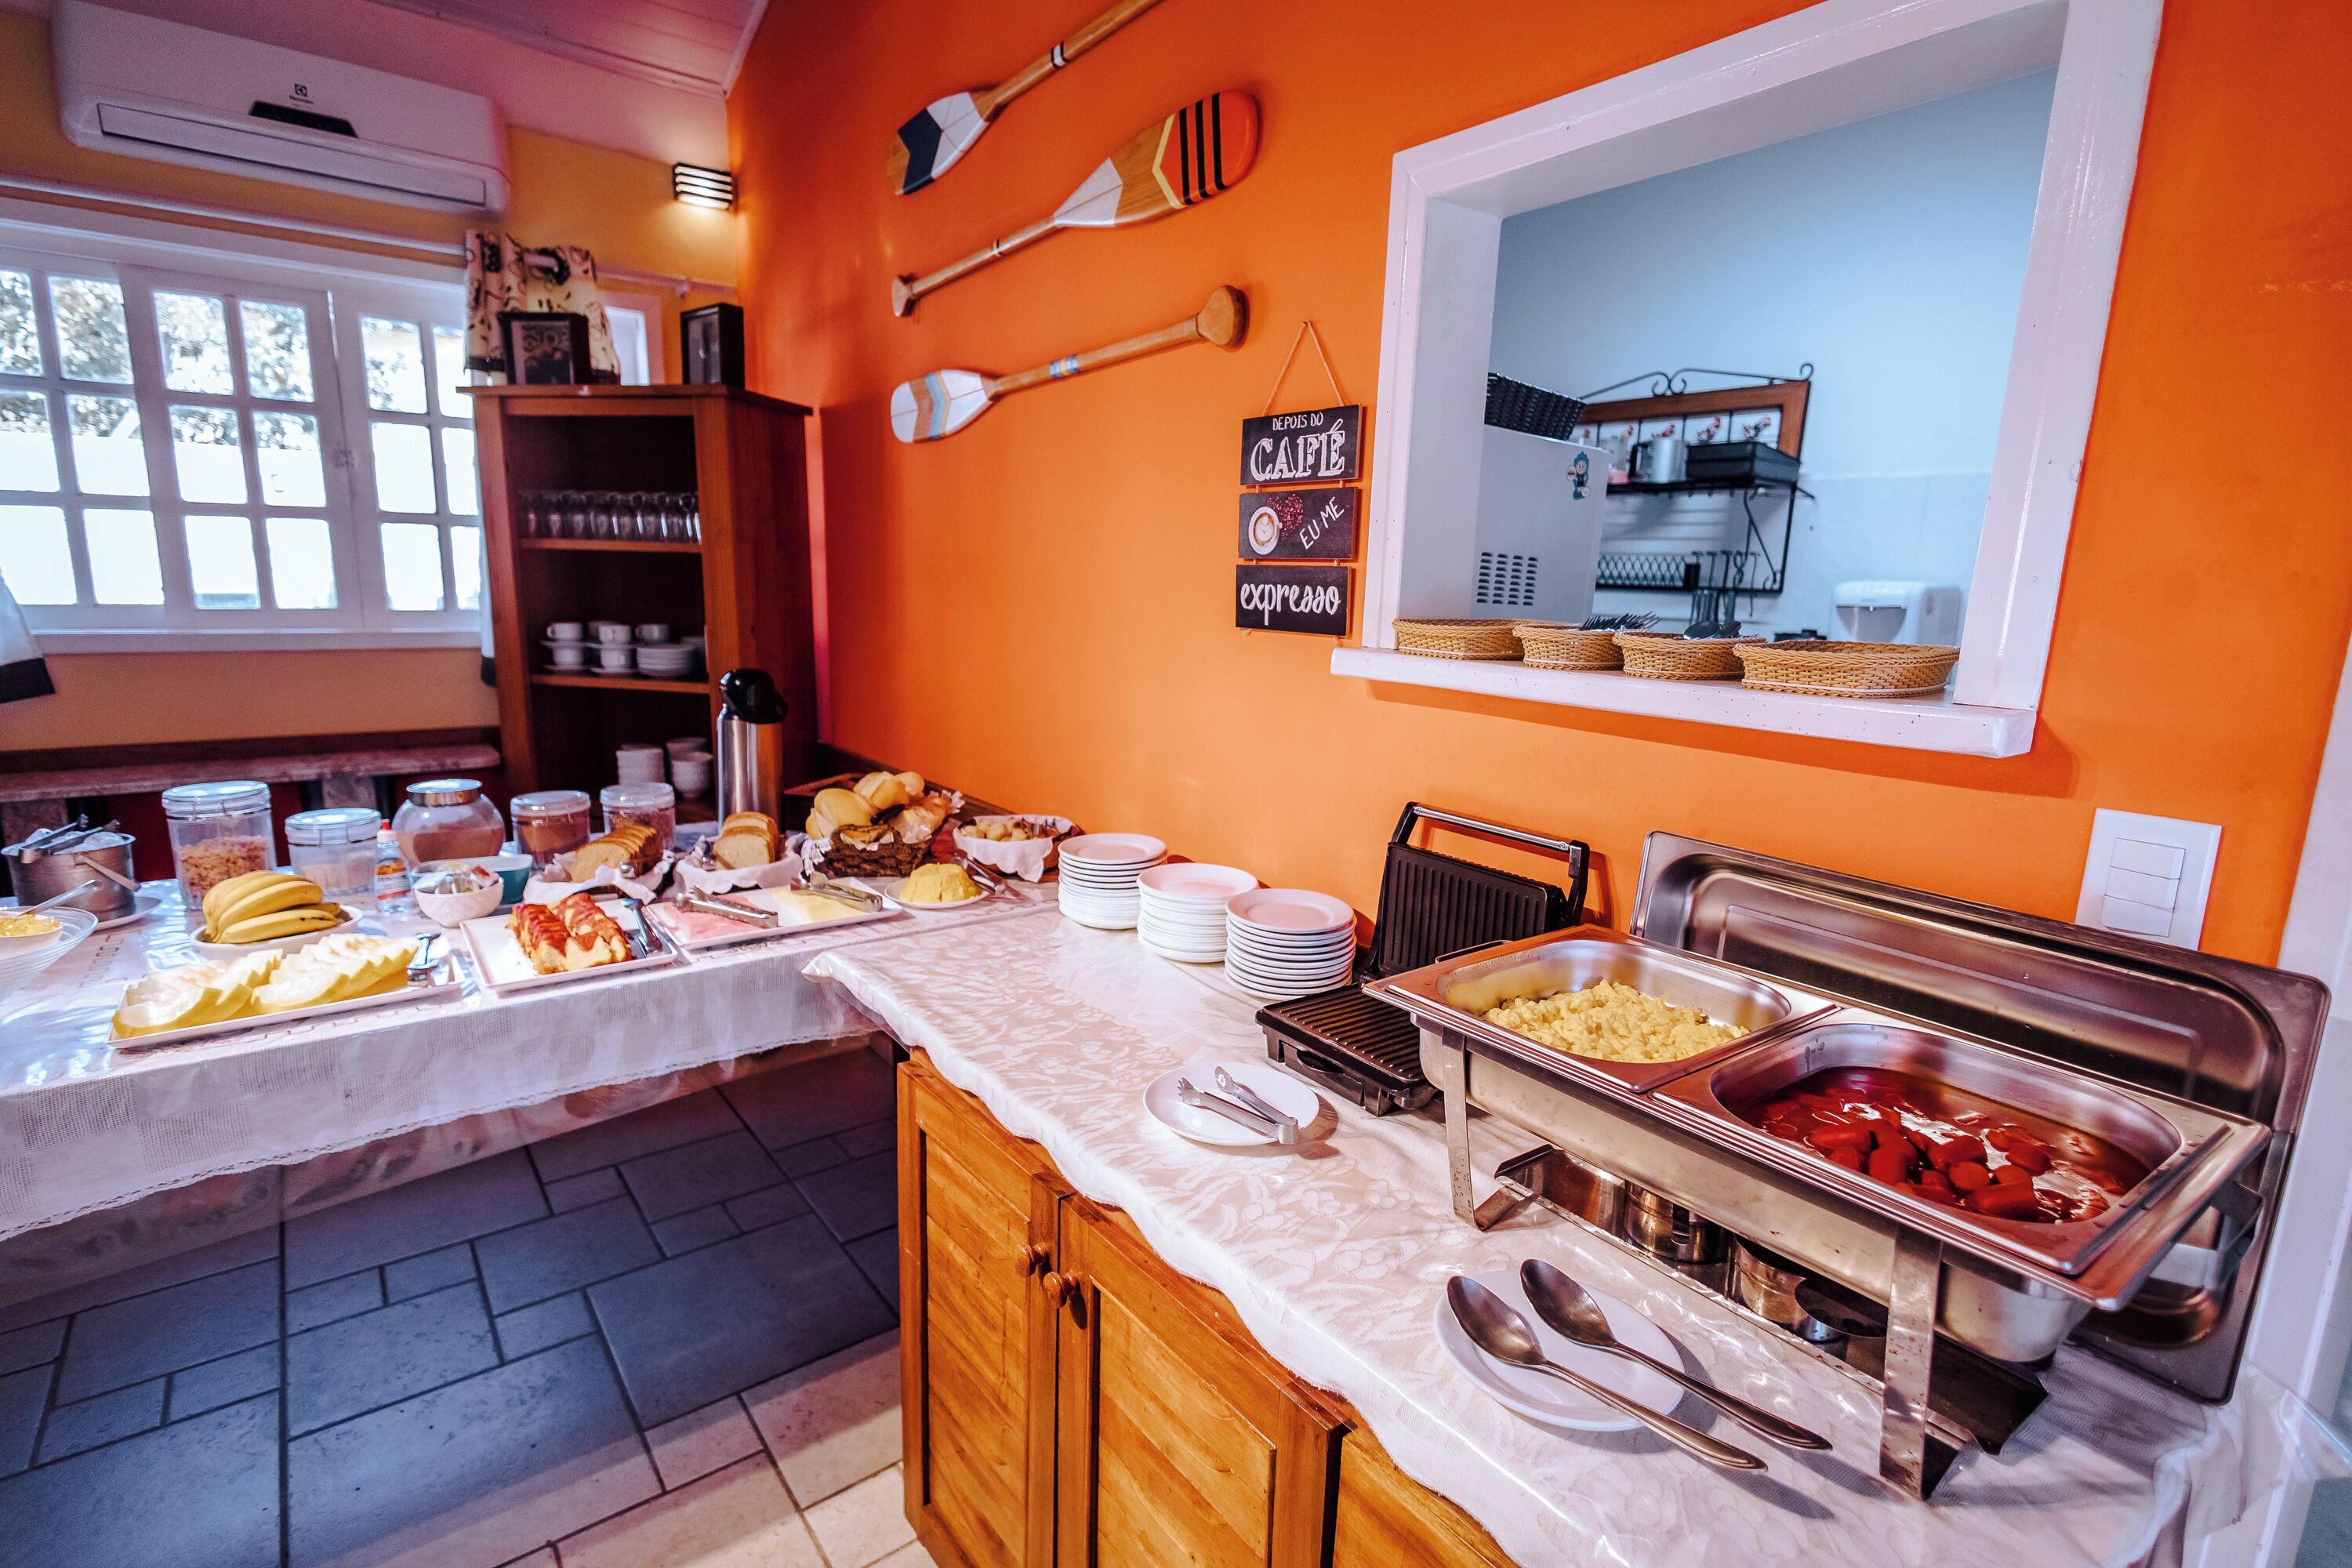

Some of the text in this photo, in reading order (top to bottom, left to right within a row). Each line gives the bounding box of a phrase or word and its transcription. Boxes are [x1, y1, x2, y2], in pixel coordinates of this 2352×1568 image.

[1272, 412, 1324, 430] DEPOIS DO
[1250, 418, 1345, 481] CAFÉ
[1299, 496, 1345, 550] EU ME
[1240, 583, 1341, 626] expresso
